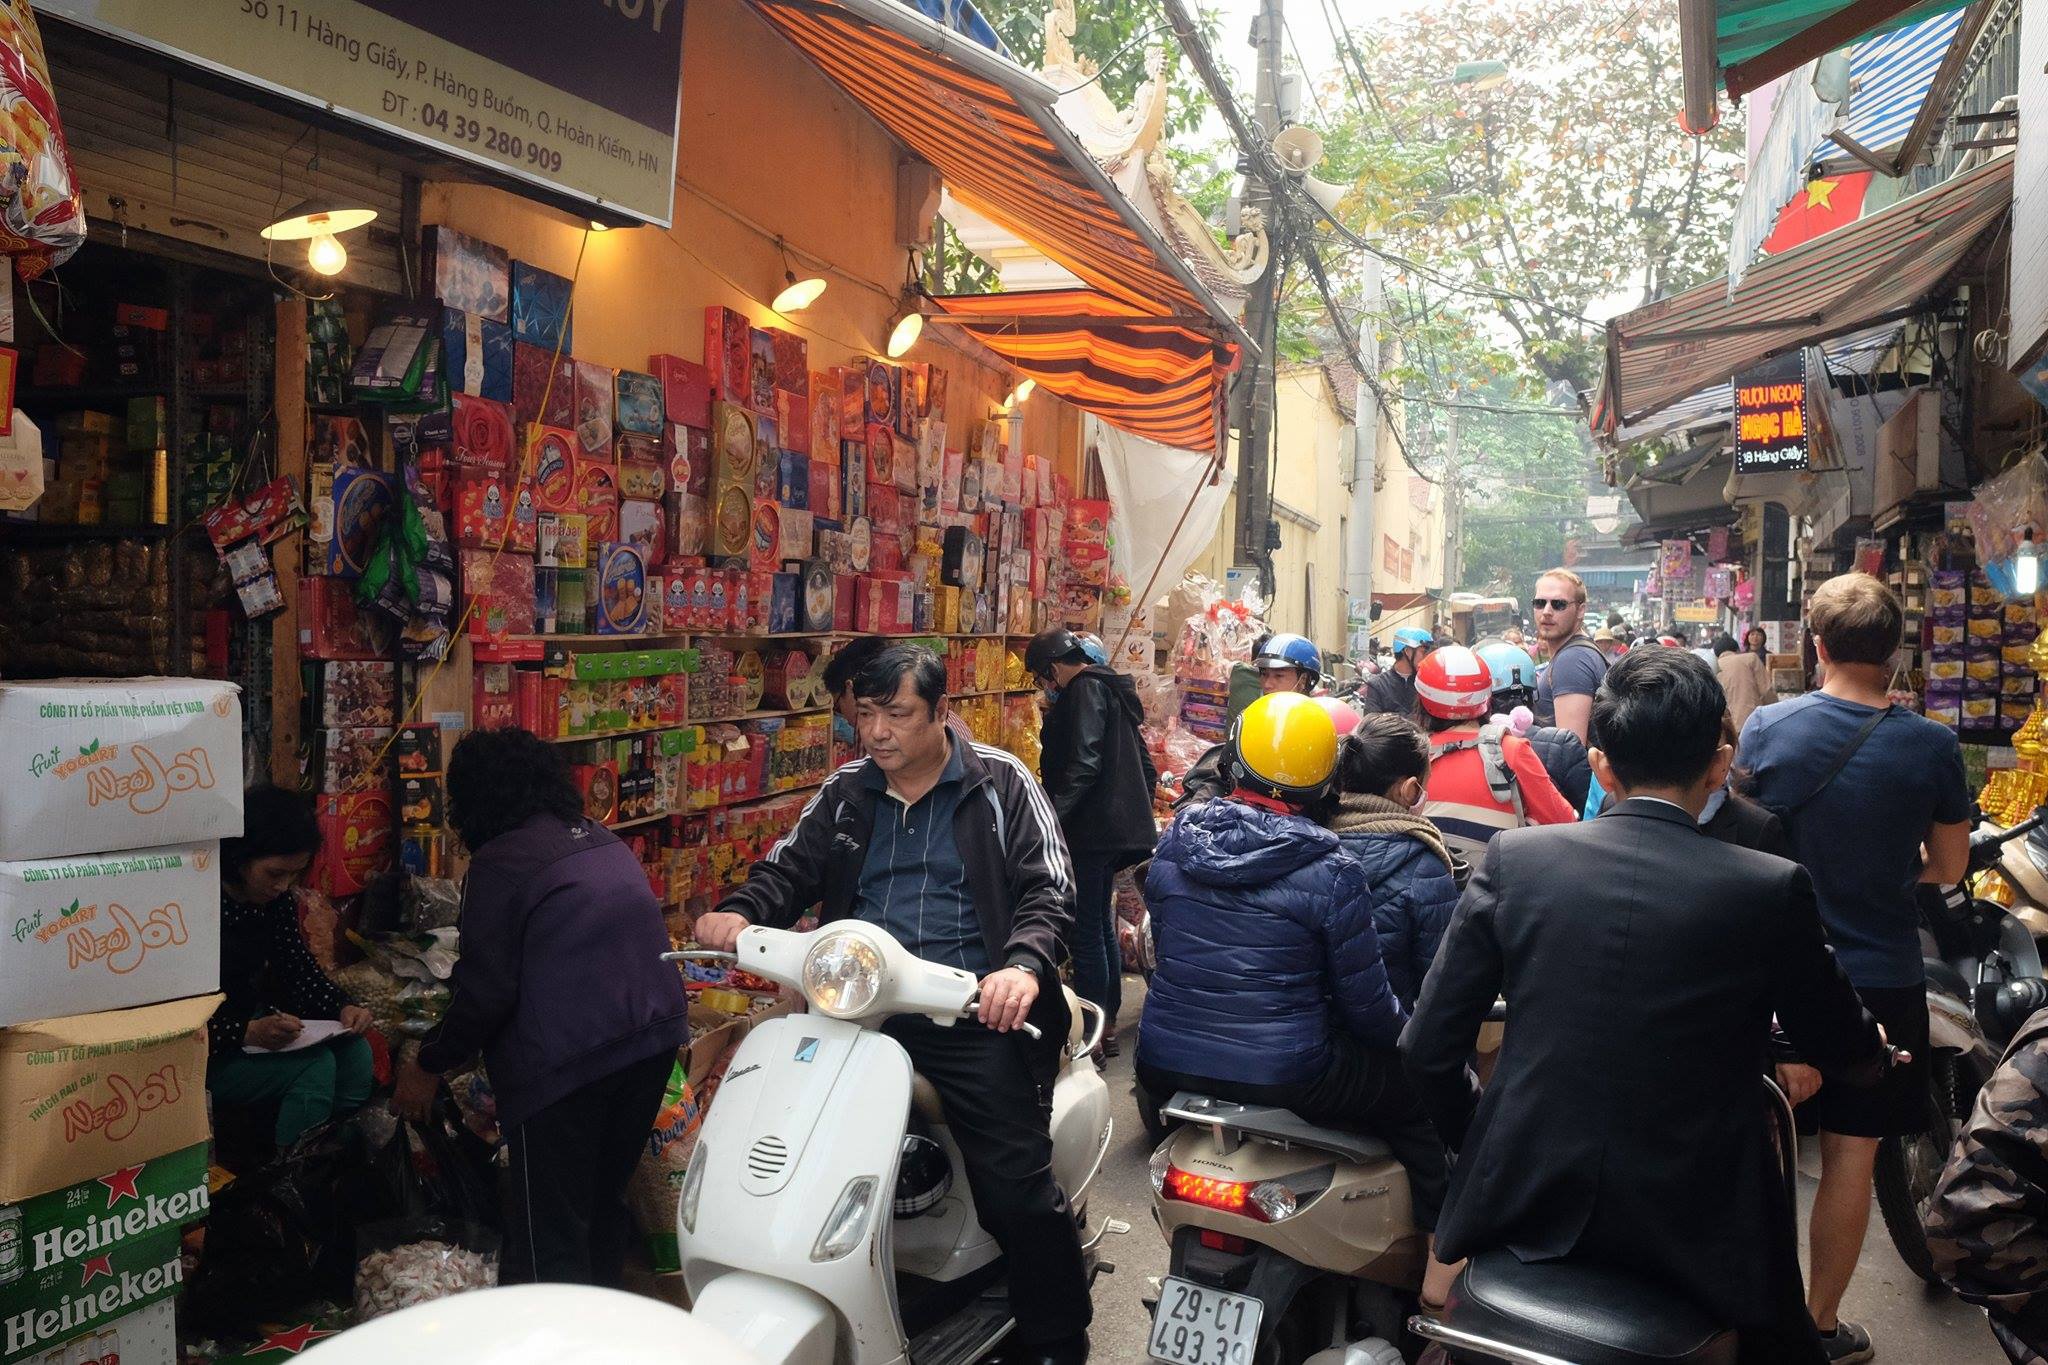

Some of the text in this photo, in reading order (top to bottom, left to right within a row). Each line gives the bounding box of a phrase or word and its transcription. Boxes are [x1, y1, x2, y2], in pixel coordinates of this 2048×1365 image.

[277, 4, 298, 32] 11
[307, 15, 360, 62] Hàng
[415, 60, 428, 84] P.
[433, 67, 478, 108] Hàng
[537, 111, 552, 134] Q.
[556, 119, 594, 148] Hoàn
[639, 153, 658, 174] HN
[421, 103, 449, 133] 04
[454, 115, 480, 142] 39
[484, 126, 523, 159] 280
[527, 142, 562, 172] 909
[40, 702, 66, 718] CÔNG
[69, 703, 79, 718] TY
[184, 700, 205, 713] NAM
[29, 746, 61, 778] fruit
[23, 869, 49, 883] CÔNG
[50, 867, 61, 881] TY
[164, 855, 183, 868] NAM
[12, 908, 43, 943] fruit
[1192, 1159, 1234, 1171] HONDA
[32, 1184, 211, 1272] Heineken
[4, 1258, 184, 1356] Heineken
[1170, 1285, 1246, 1335] 29-C1
